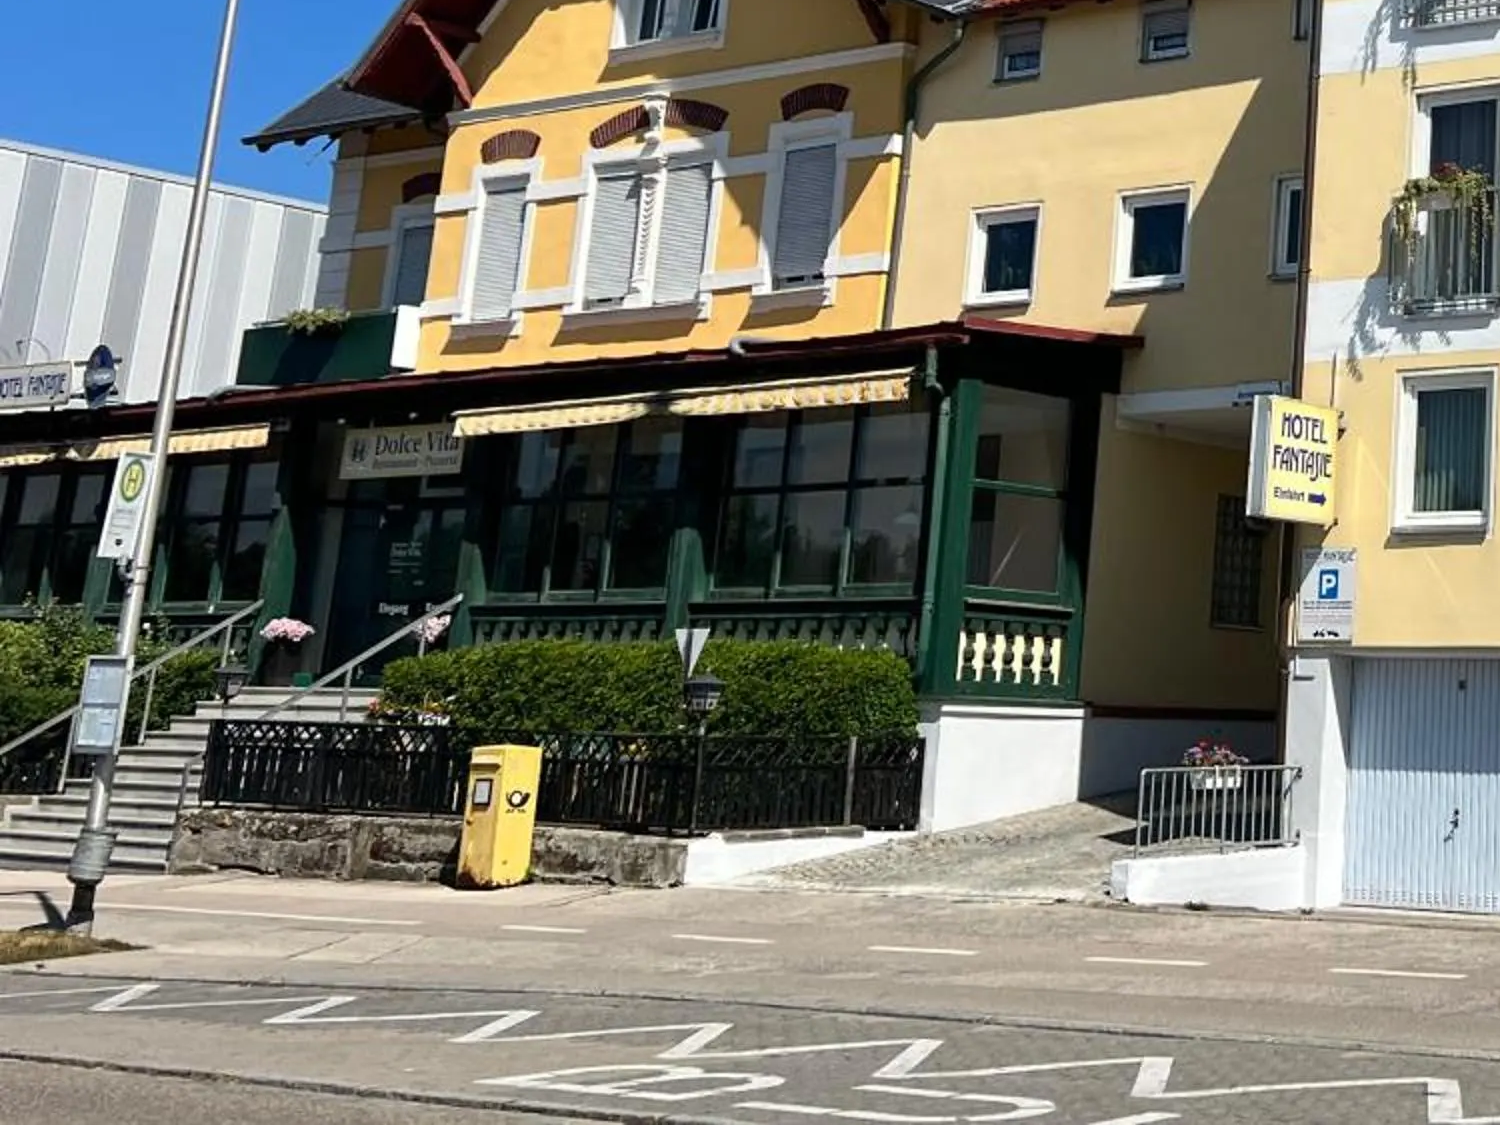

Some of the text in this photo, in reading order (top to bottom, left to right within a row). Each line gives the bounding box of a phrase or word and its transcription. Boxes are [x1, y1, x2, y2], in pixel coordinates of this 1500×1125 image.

[1281, 411, 1328, 445] HOTEL
[374, 430, 460, 456] Dolce Vita
[1272, 444, 1332, 481] FANTASIE
[1273, 486, 1305, 502] Einfahrt
[1321, 574, 1337, 595] P
